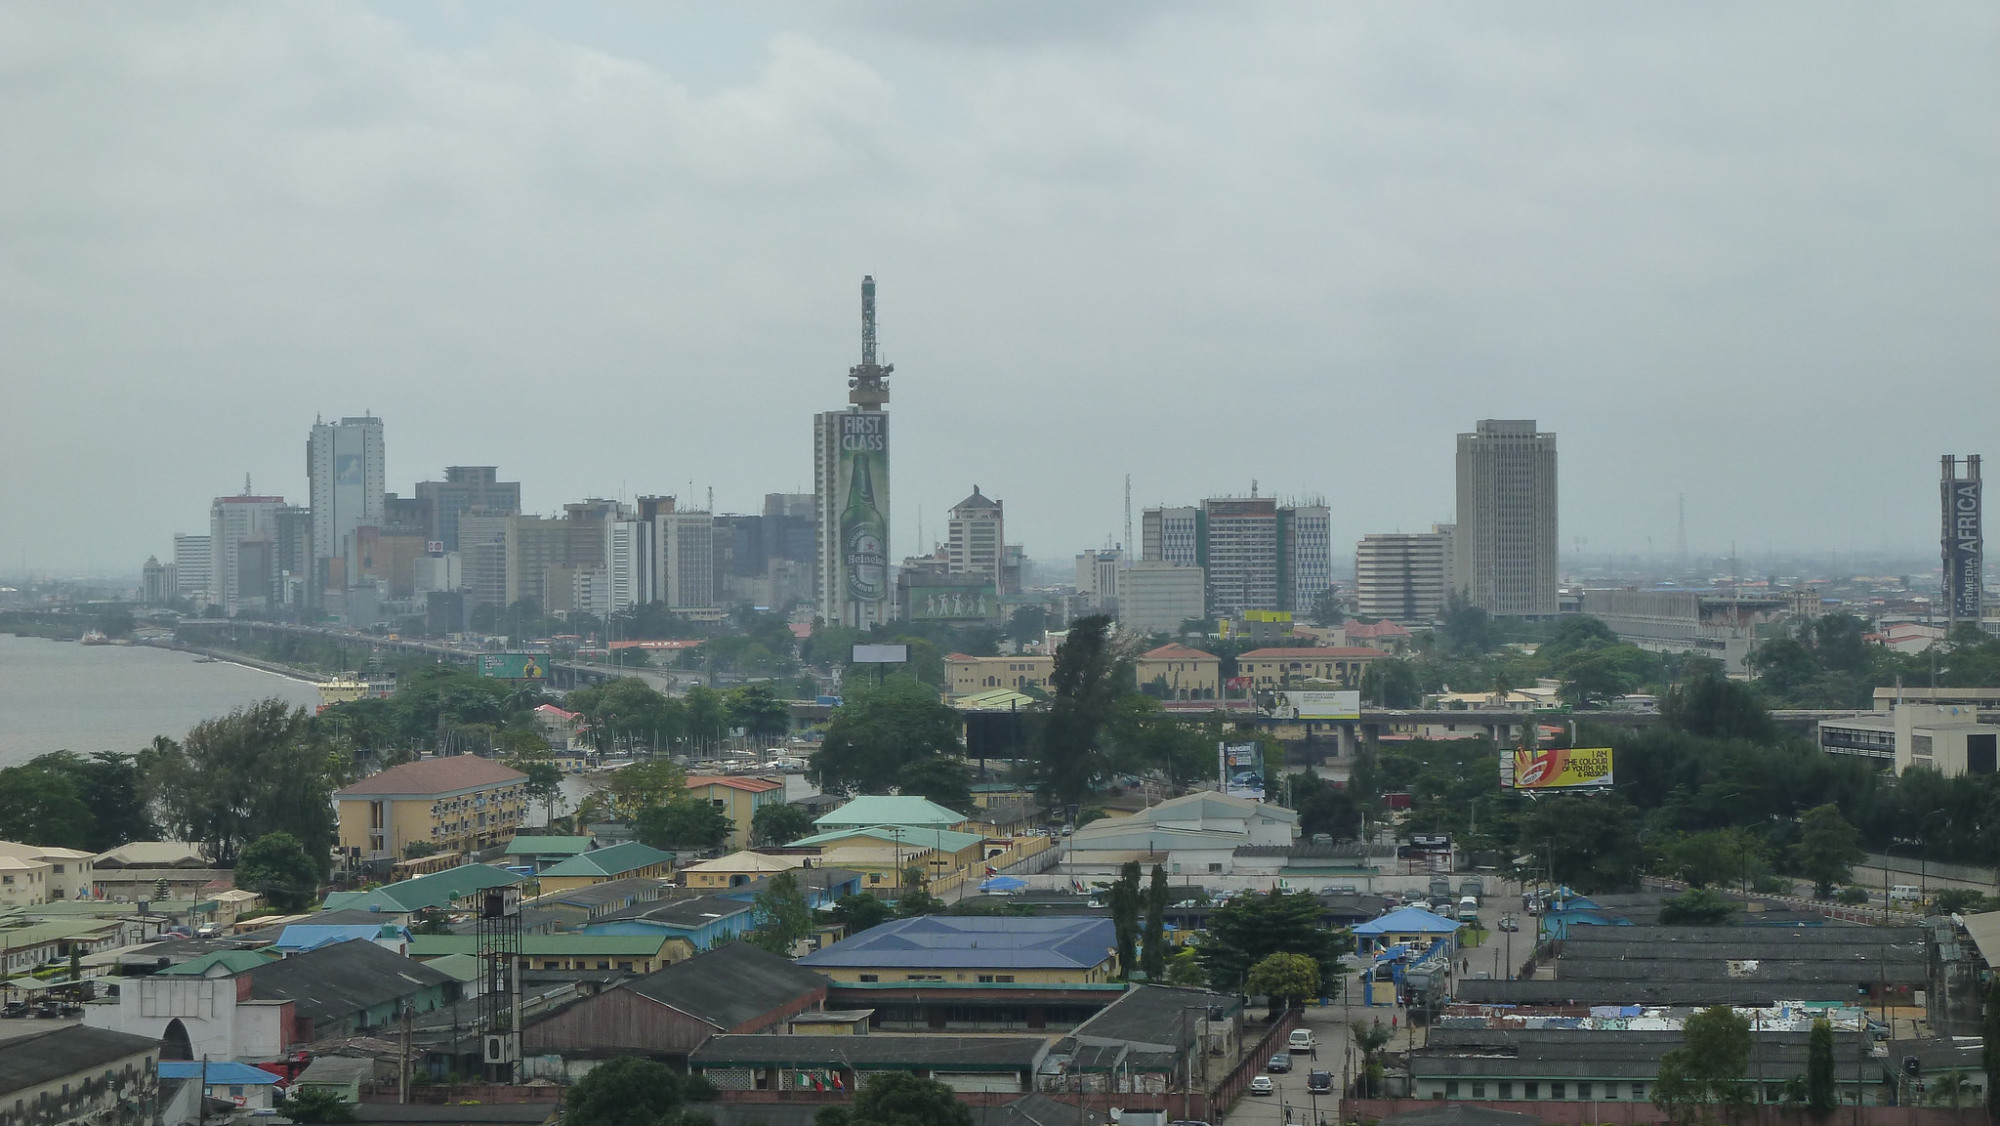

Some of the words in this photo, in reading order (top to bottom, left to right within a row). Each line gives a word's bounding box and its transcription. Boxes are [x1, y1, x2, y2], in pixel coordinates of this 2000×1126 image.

[842, 434, 883, 450] CLASS
[844, 416, 880, 434] FIRST
[1957, 484, 1977, 553] AFRICA
[1964, 557, 1974, 611] PRIMEDIA
